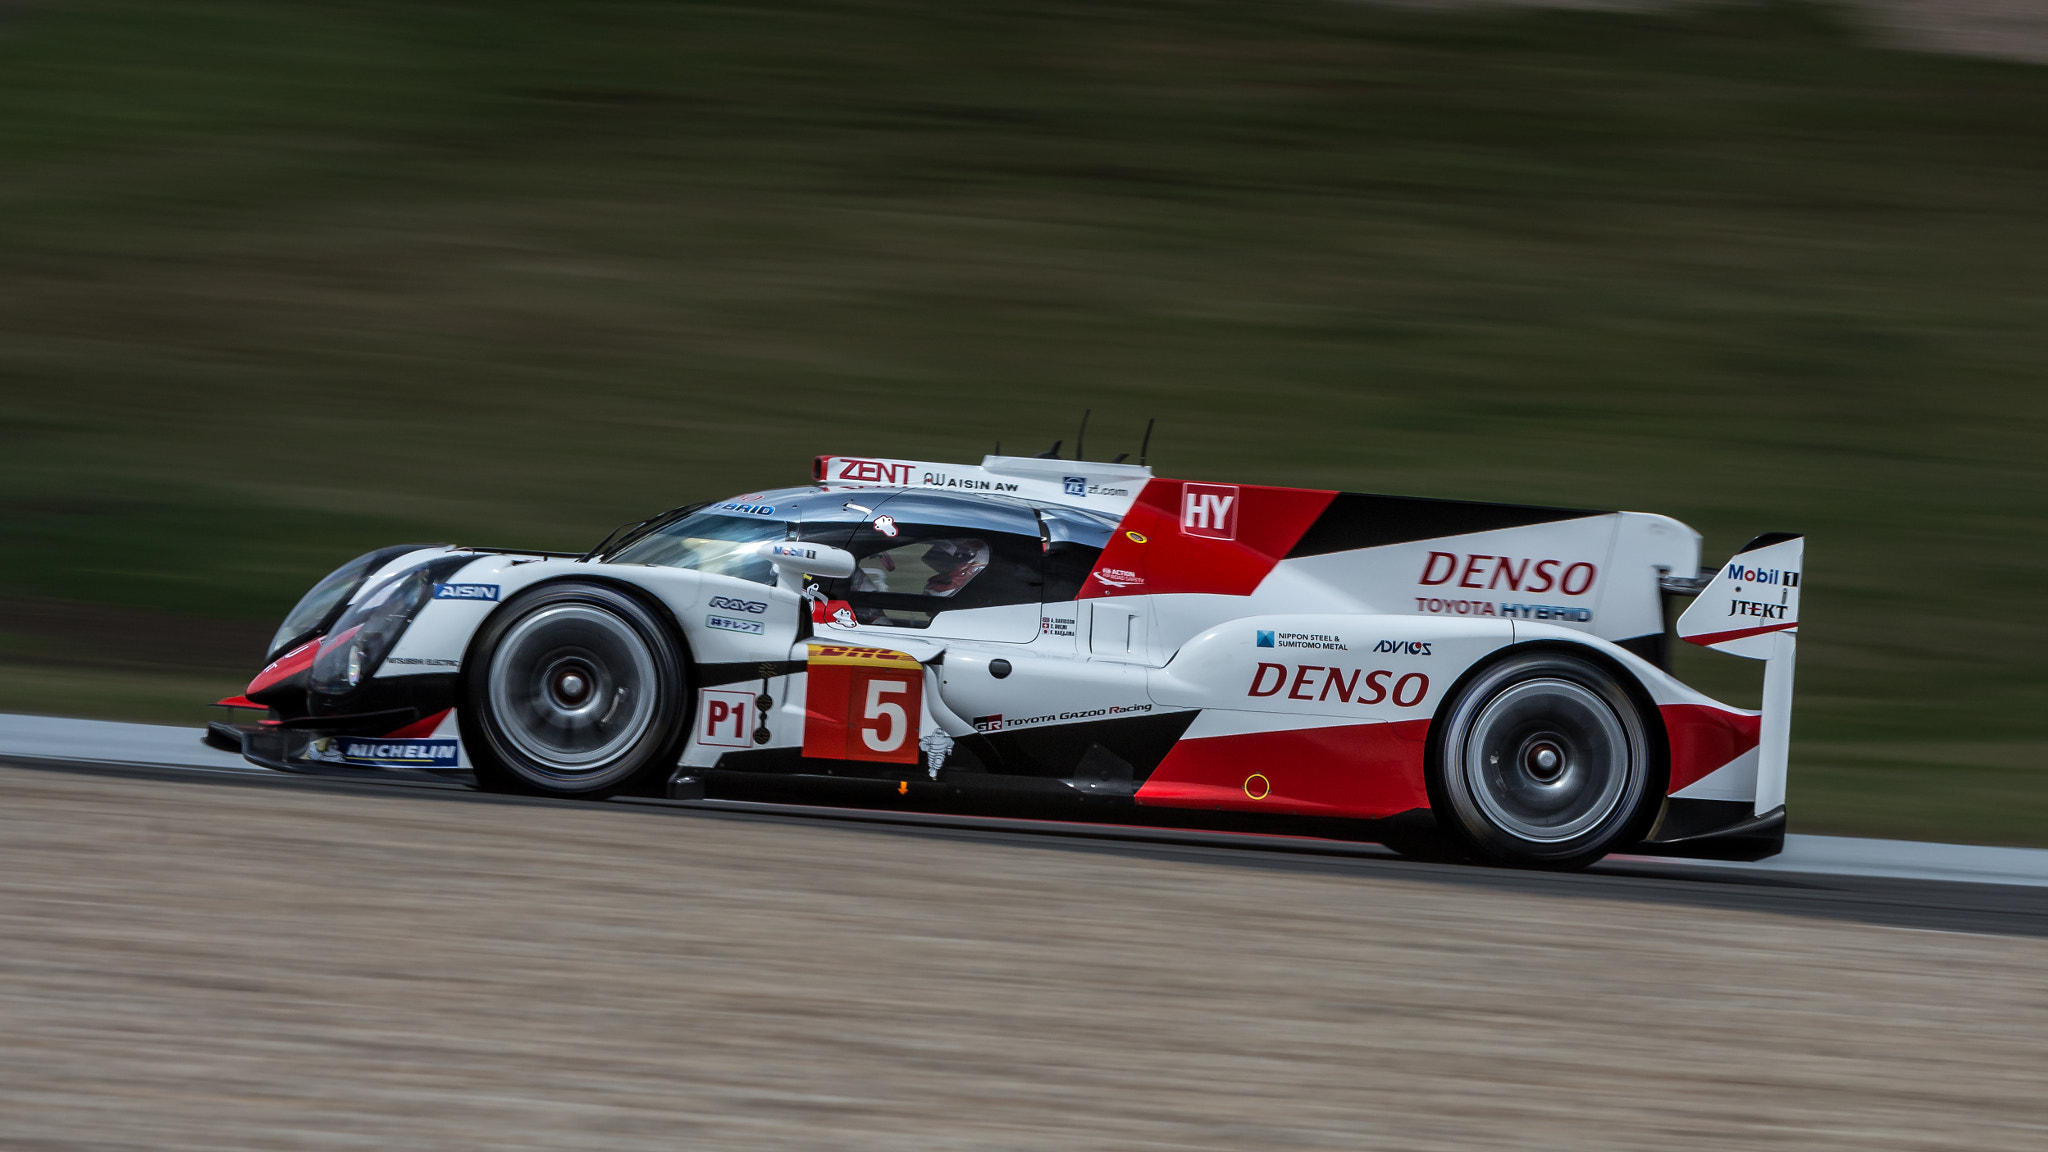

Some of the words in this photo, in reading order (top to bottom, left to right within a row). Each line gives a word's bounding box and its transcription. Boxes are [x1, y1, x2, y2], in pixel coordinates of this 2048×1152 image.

[840, 459, 915, 485] ZENT
[947, 478, 990, 490] AISIN
[995, 482, 1018, 492] AW
[1088, 485, 1128, 496] zf.com
[1184, 493, 1234, 530] HY
[773, 546, 804, 557] Mobil
[1112, 569, 1135, 577] ACTION
[1418, 551, 1597, 596] DENSO
[1728, 564, 1779, 585] Mobil
[1783, 571, 1799, 587] 1
[438, 586, 497, 598] AISIN
[709, 596, 768, 614] RAYS
[1416, 598, 1496, 616] TOYOTA
[1501, 603, 1592, 622] HYBRID
[1728, 600, 1788, 619] JTEKT
[820, 645, 899, 660] DHL
[1278, 641, 1320, 649] SUMITOMO
[1322, 643, 1348, 651] METAL
[1373, 640, 1432, 656] ADVICS
[1248, 662, 1430, 708] DENSO
[706, 700, 746, 739] P1
[862, 679, 908, 753] 5
[1005, 714, 1056, 727] TOYOTA
[1060, 708, 1106, 721] GAZOO
[1109, 703, 1153, 715] Racing
[347, 744, 456, 759] MICHELIN
